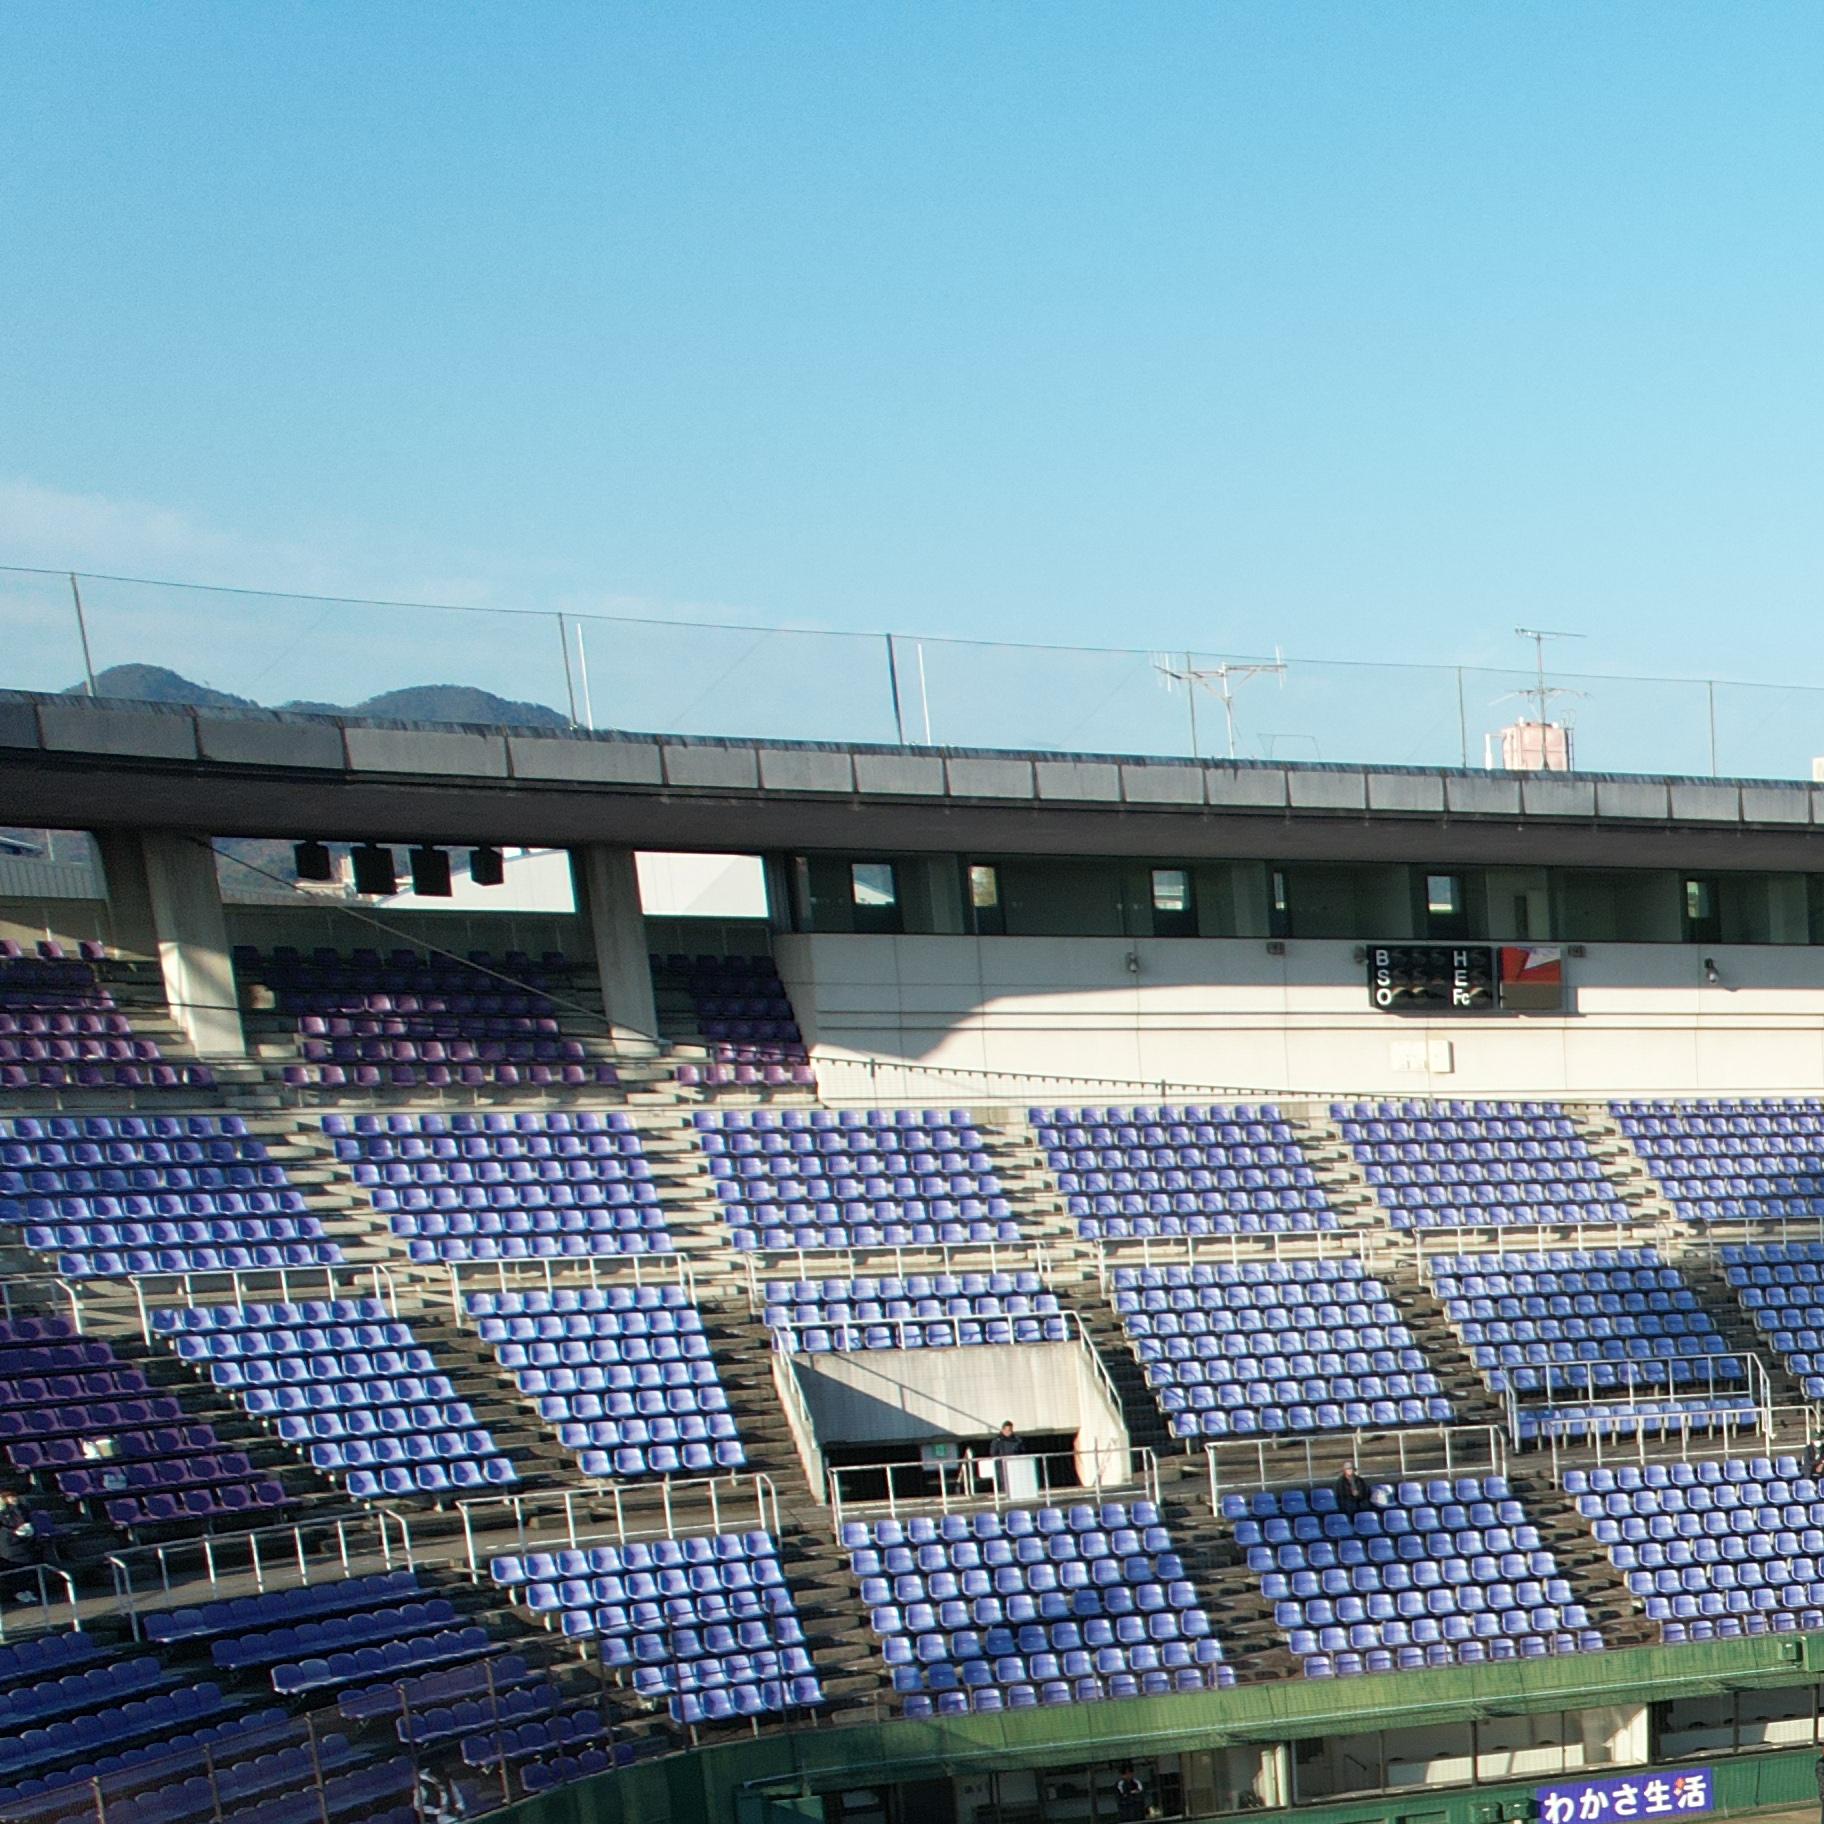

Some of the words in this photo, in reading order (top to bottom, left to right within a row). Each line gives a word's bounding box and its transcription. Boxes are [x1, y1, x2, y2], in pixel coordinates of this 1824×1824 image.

[1376, 950, 1389, 966] B
[1453, 950, 1467, 966] H
[1377, 970, 1391, 986] S
[1454, 970, 1468, 987] E
[1544, 1775, 1707, 1824] わかさ生活
